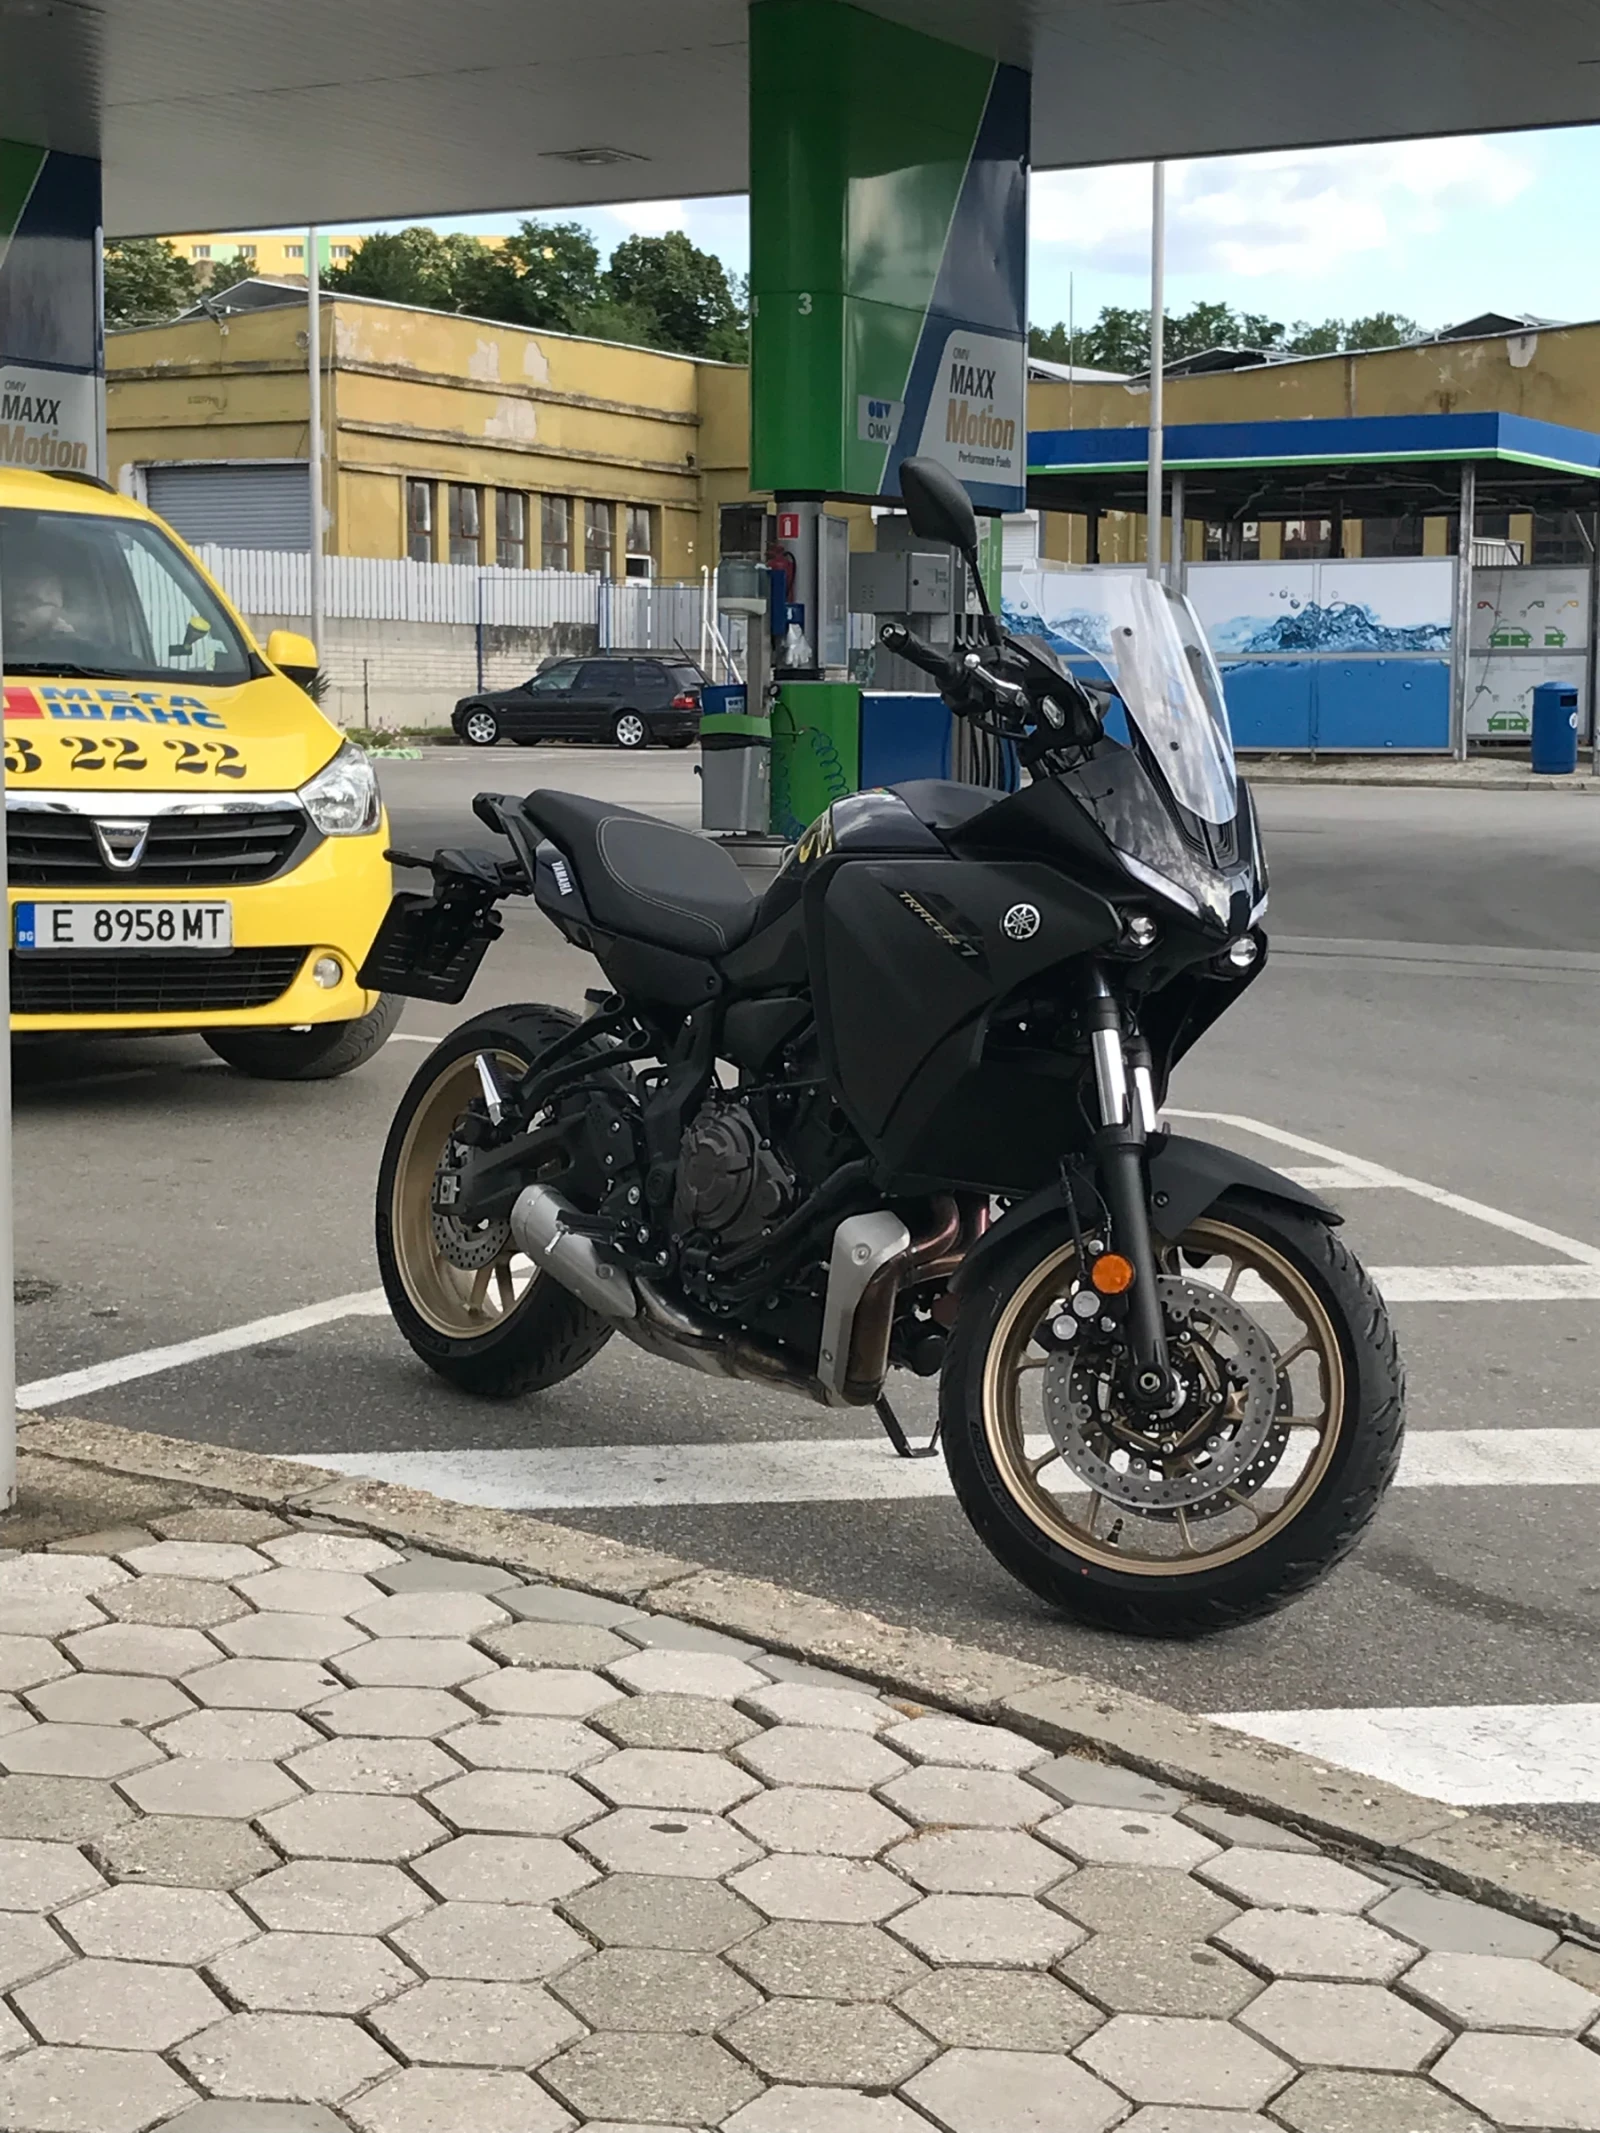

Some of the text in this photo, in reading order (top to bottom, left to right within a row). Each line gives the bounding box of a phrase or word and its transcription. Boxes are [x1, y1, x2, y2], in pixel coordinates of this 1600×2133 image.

[798, 292, 812, 315] 3
[953, 347, 970, 361] OMV
[4, 380, 26, 392] OMV
[949, 363, 996, 399] MAXX
[1, 394, 61, 425] MAXX
[868, 423, 891, 440] OMV
[945, 398, 1015, 451] Motion
[0, 424, 88, 469] Motion
[958, 450, 1011, 469] Performance Fuels
[38, 686, 210, 711] МЕГА
[46, 703, 227, 729] ШАНС
[60, 736, 147, 771] 22
[163, 739, 247, 780] 22
[551, 861, 573, 896] YAMAHA
[53, 909, 224, 942] E 8958 MT
[899, 891, 960, 946] TRACER
[19, 931, 34, 942] BG
